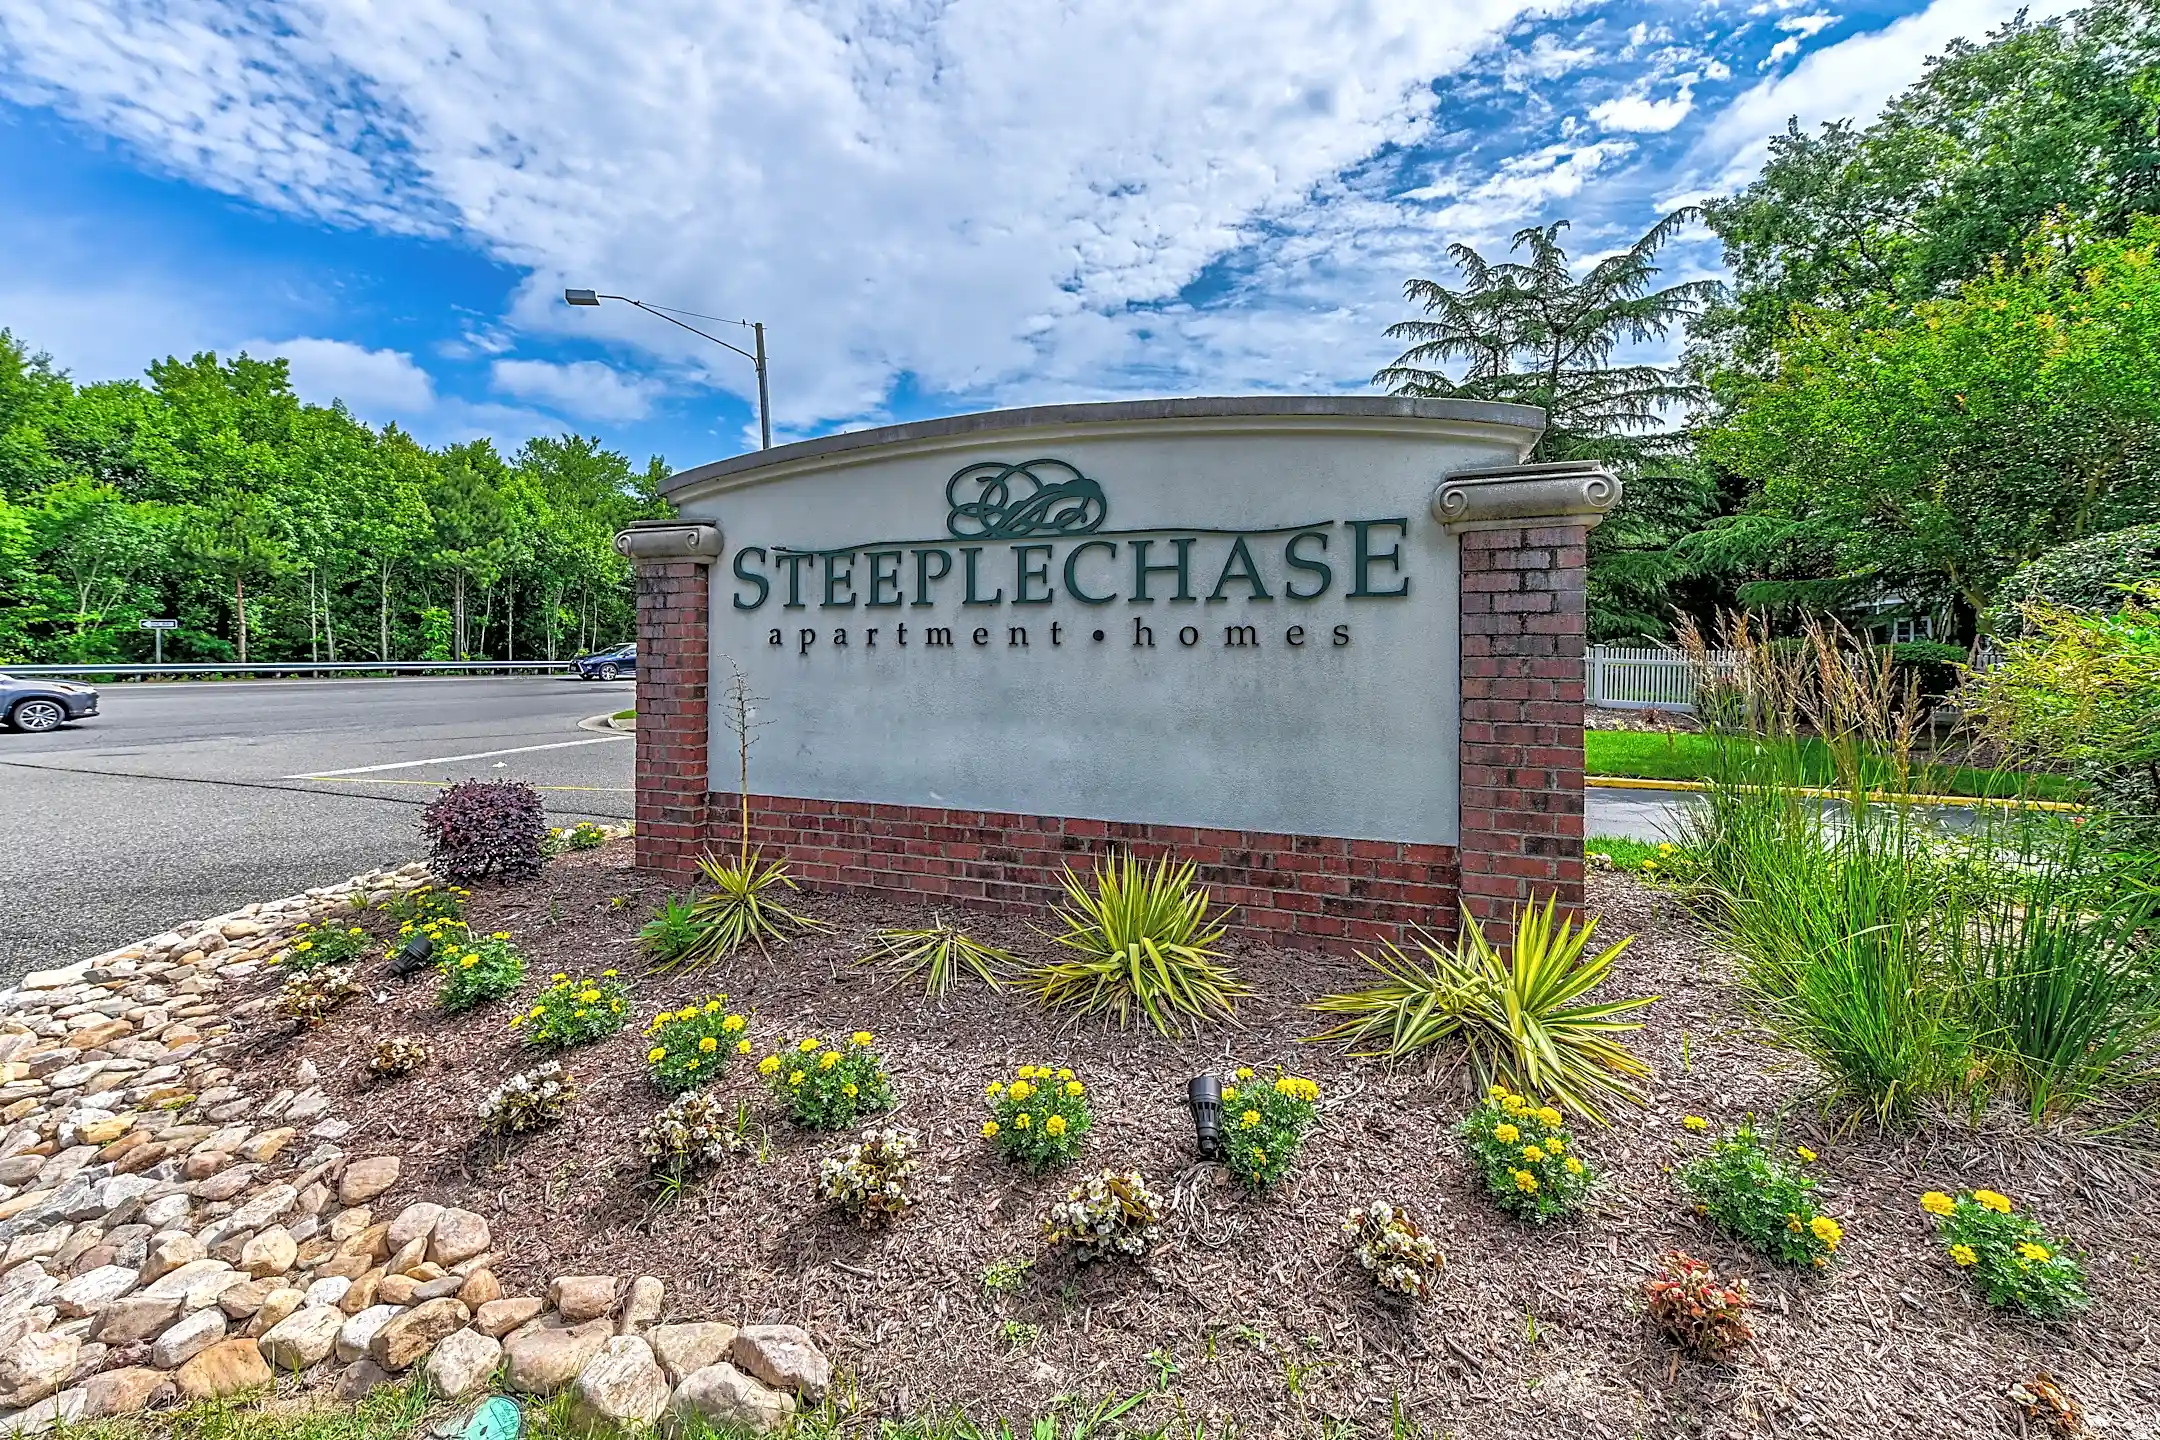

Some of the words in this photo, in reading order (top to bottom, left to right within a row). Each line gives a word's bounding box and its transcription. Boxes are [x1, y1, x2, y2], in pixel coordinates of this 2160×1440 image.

[732, 517, 1410, 611] STEEPLECHASE
[767, 622, 1063, 656] apartment
[1131, 616, 1351, 648] homes
